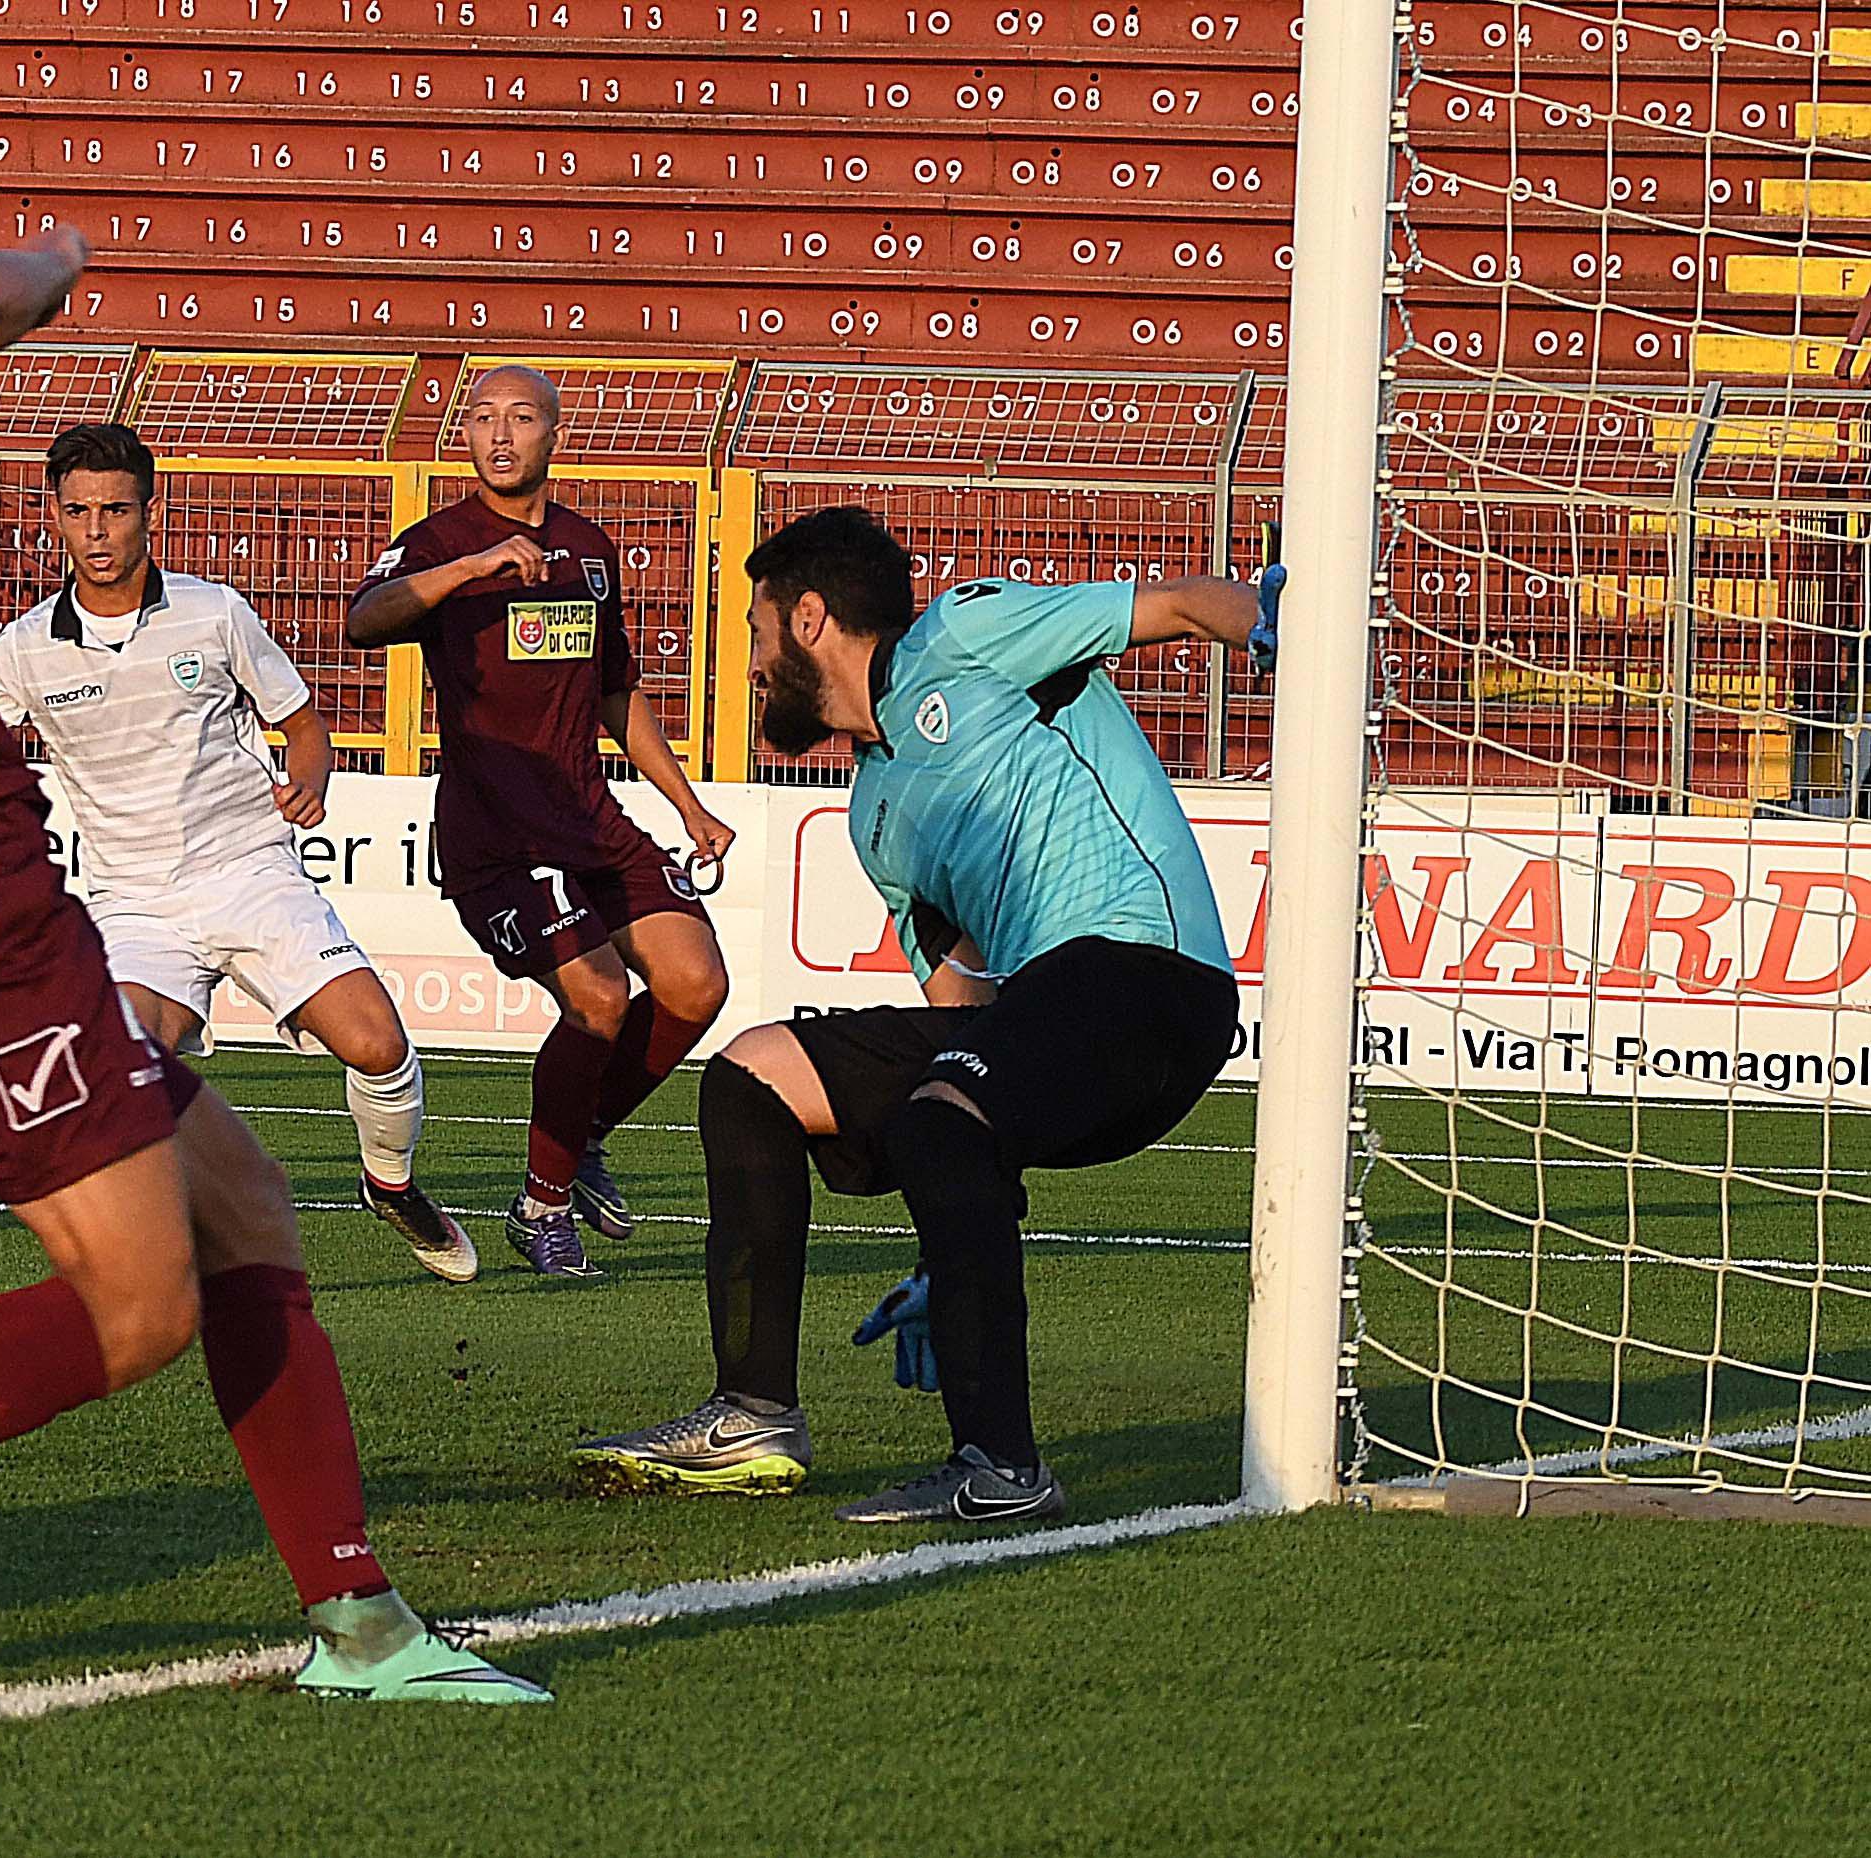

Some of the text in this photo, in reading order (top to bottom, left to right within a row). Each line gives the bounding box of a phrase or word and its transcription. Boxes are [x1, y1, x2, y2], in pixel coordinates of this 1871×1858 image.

[158, 0, 1139, 37] 18 17 15 14 12 11 09 08
[16, 64, 56, 88] 19
[110, 67, 148, 90] 18
[297, 72, 337, 96] 16
[391, 74, 431, 98] 15
[580, 78, 619, 102] 13
[675, 80, 715, 105] 12
[865, 84, 909, 108] 10
[956, 85, 1004, 110] 09
[1152, 89, 1200, 114] 07
[1251, 92, 1299, 116] 06
[1742, 103, 1787, 129] 01
[63, 139, 102, 163] 18
[157, 141, 197, 166] 17
[346, 147, 386, 171] 15
[441, 149, 482, 174] 14
[632, 153, 672, 178] 12
[727, 155, 764, 179] 11
[914, 159, 962, 183] 09
[1012, 160, 1059, 185] 08
[1212, 166, 1261, 191] 06
[111, 216, 151, 241] 17
[301, 222, 342, 246] 15
[397, 224, 438, 249] 14
[589, 229, 630, 254] 12
[686, 230, 723, 255] 11
[873, 234, 923, 259] 09
[972, 236, 1020, 261] 08
[1174, 242, 1223, 268] 06
[1573, 253, 1622, 279] 02
[1841, 269, 1855, 291] F
[254, 297, 295, 322] 15
[350, 300, 391, 324] 14
[544, 304, 585, 329] 12
[642, 307, 678, 331] 11
[830, 310, 879, 336] 09
[929, 312, 978, 339] 08
[1132, 319, 1181, 344] 06
[1234, 322, 1284, 348] 05
[1534, 330, 1584, 356] 02
[1635, 333, 1682, 359] 01
[1806, 347, 1819, 369] E
[44, 685, 103, 706] macron
[530, 867, 571, 915] 7
[1462, 1029, 1536, 1072] Via
